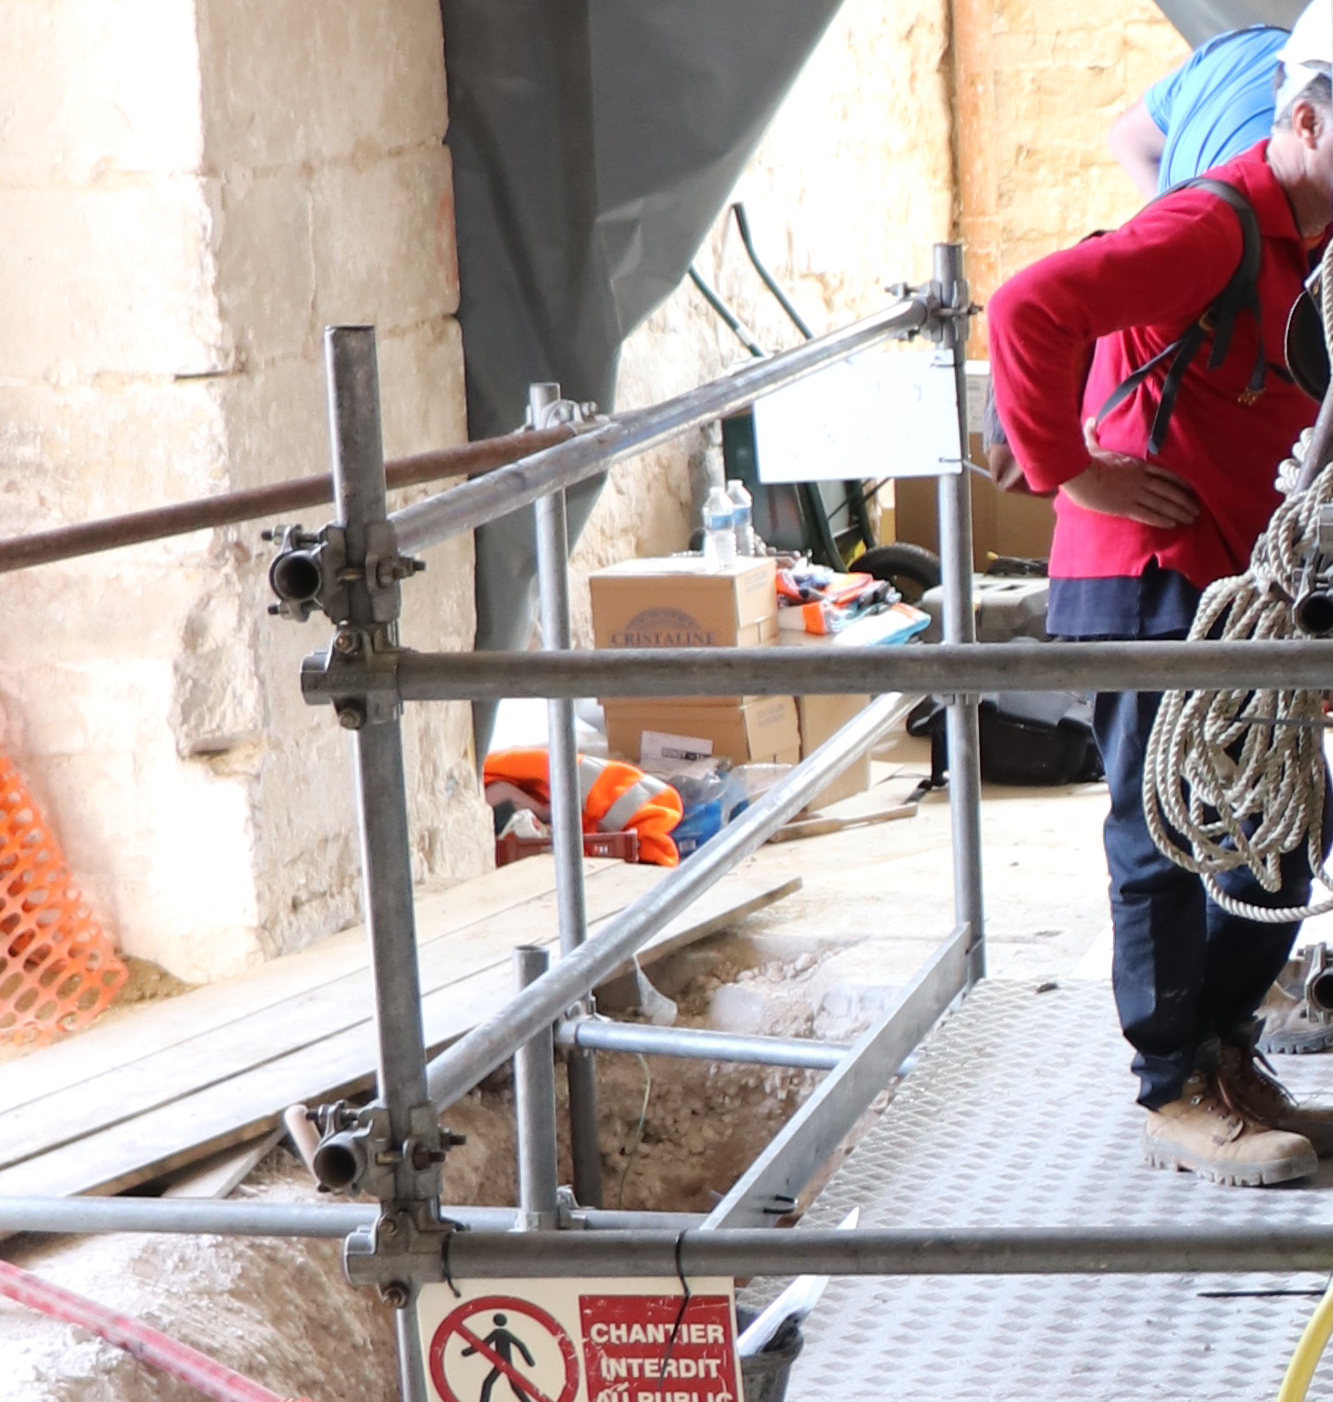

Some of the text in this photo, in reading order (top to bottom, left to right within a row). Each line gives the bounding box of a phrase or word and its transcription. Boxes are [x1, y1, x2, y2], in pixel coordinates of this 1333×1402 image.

[611, 632, 716, 646] CRISTALINE
[590, 1324, 725, 1345] CHANTIER
[601, 1358, 721, 1380] INTERDIT
